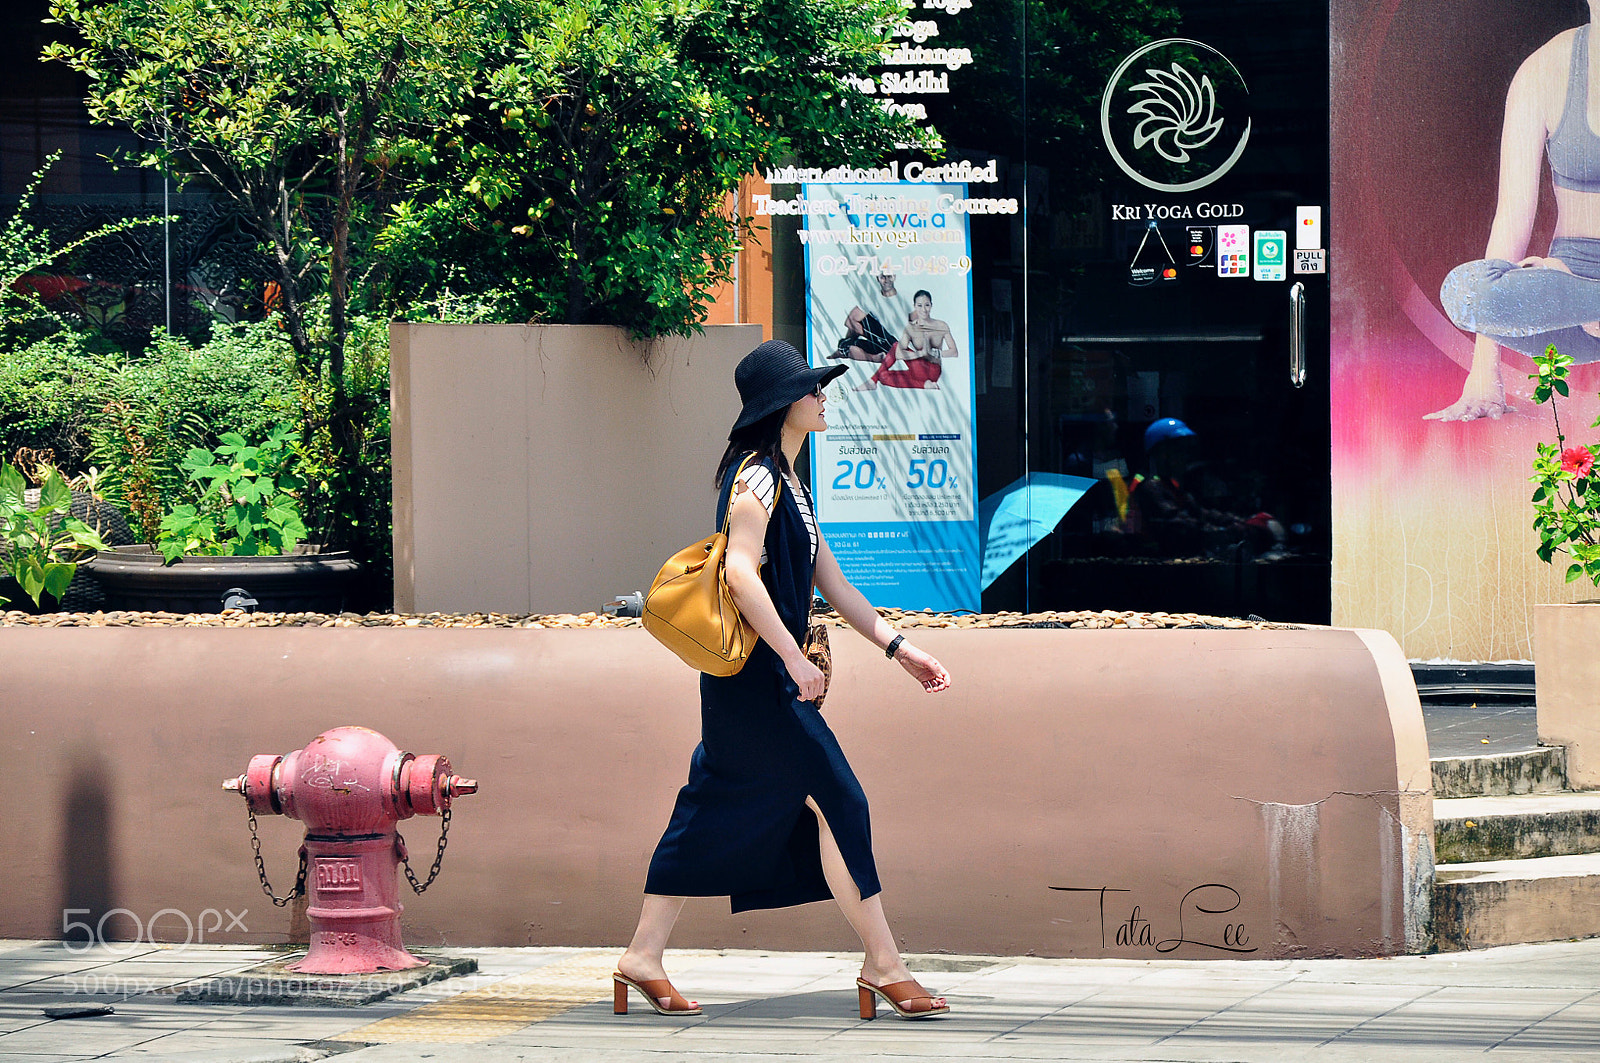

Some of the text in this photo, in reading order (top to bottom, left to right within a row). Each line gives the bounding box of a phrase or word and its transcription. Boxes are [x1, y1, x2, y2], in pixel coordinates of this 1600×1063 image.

[880, 70, 949, 93] Siddhi
[903, 160, 998, 183] Certified
[752, 193, 1018, 219] Teachers Training Courses
[797, 226, 963, 247] www.kriyoga.com
[1296, 252, 1322, 260] PULL
[838, 445, 878, 456] รับส่วนลด
[911, 444, 950, 455] รับส่วนลด
